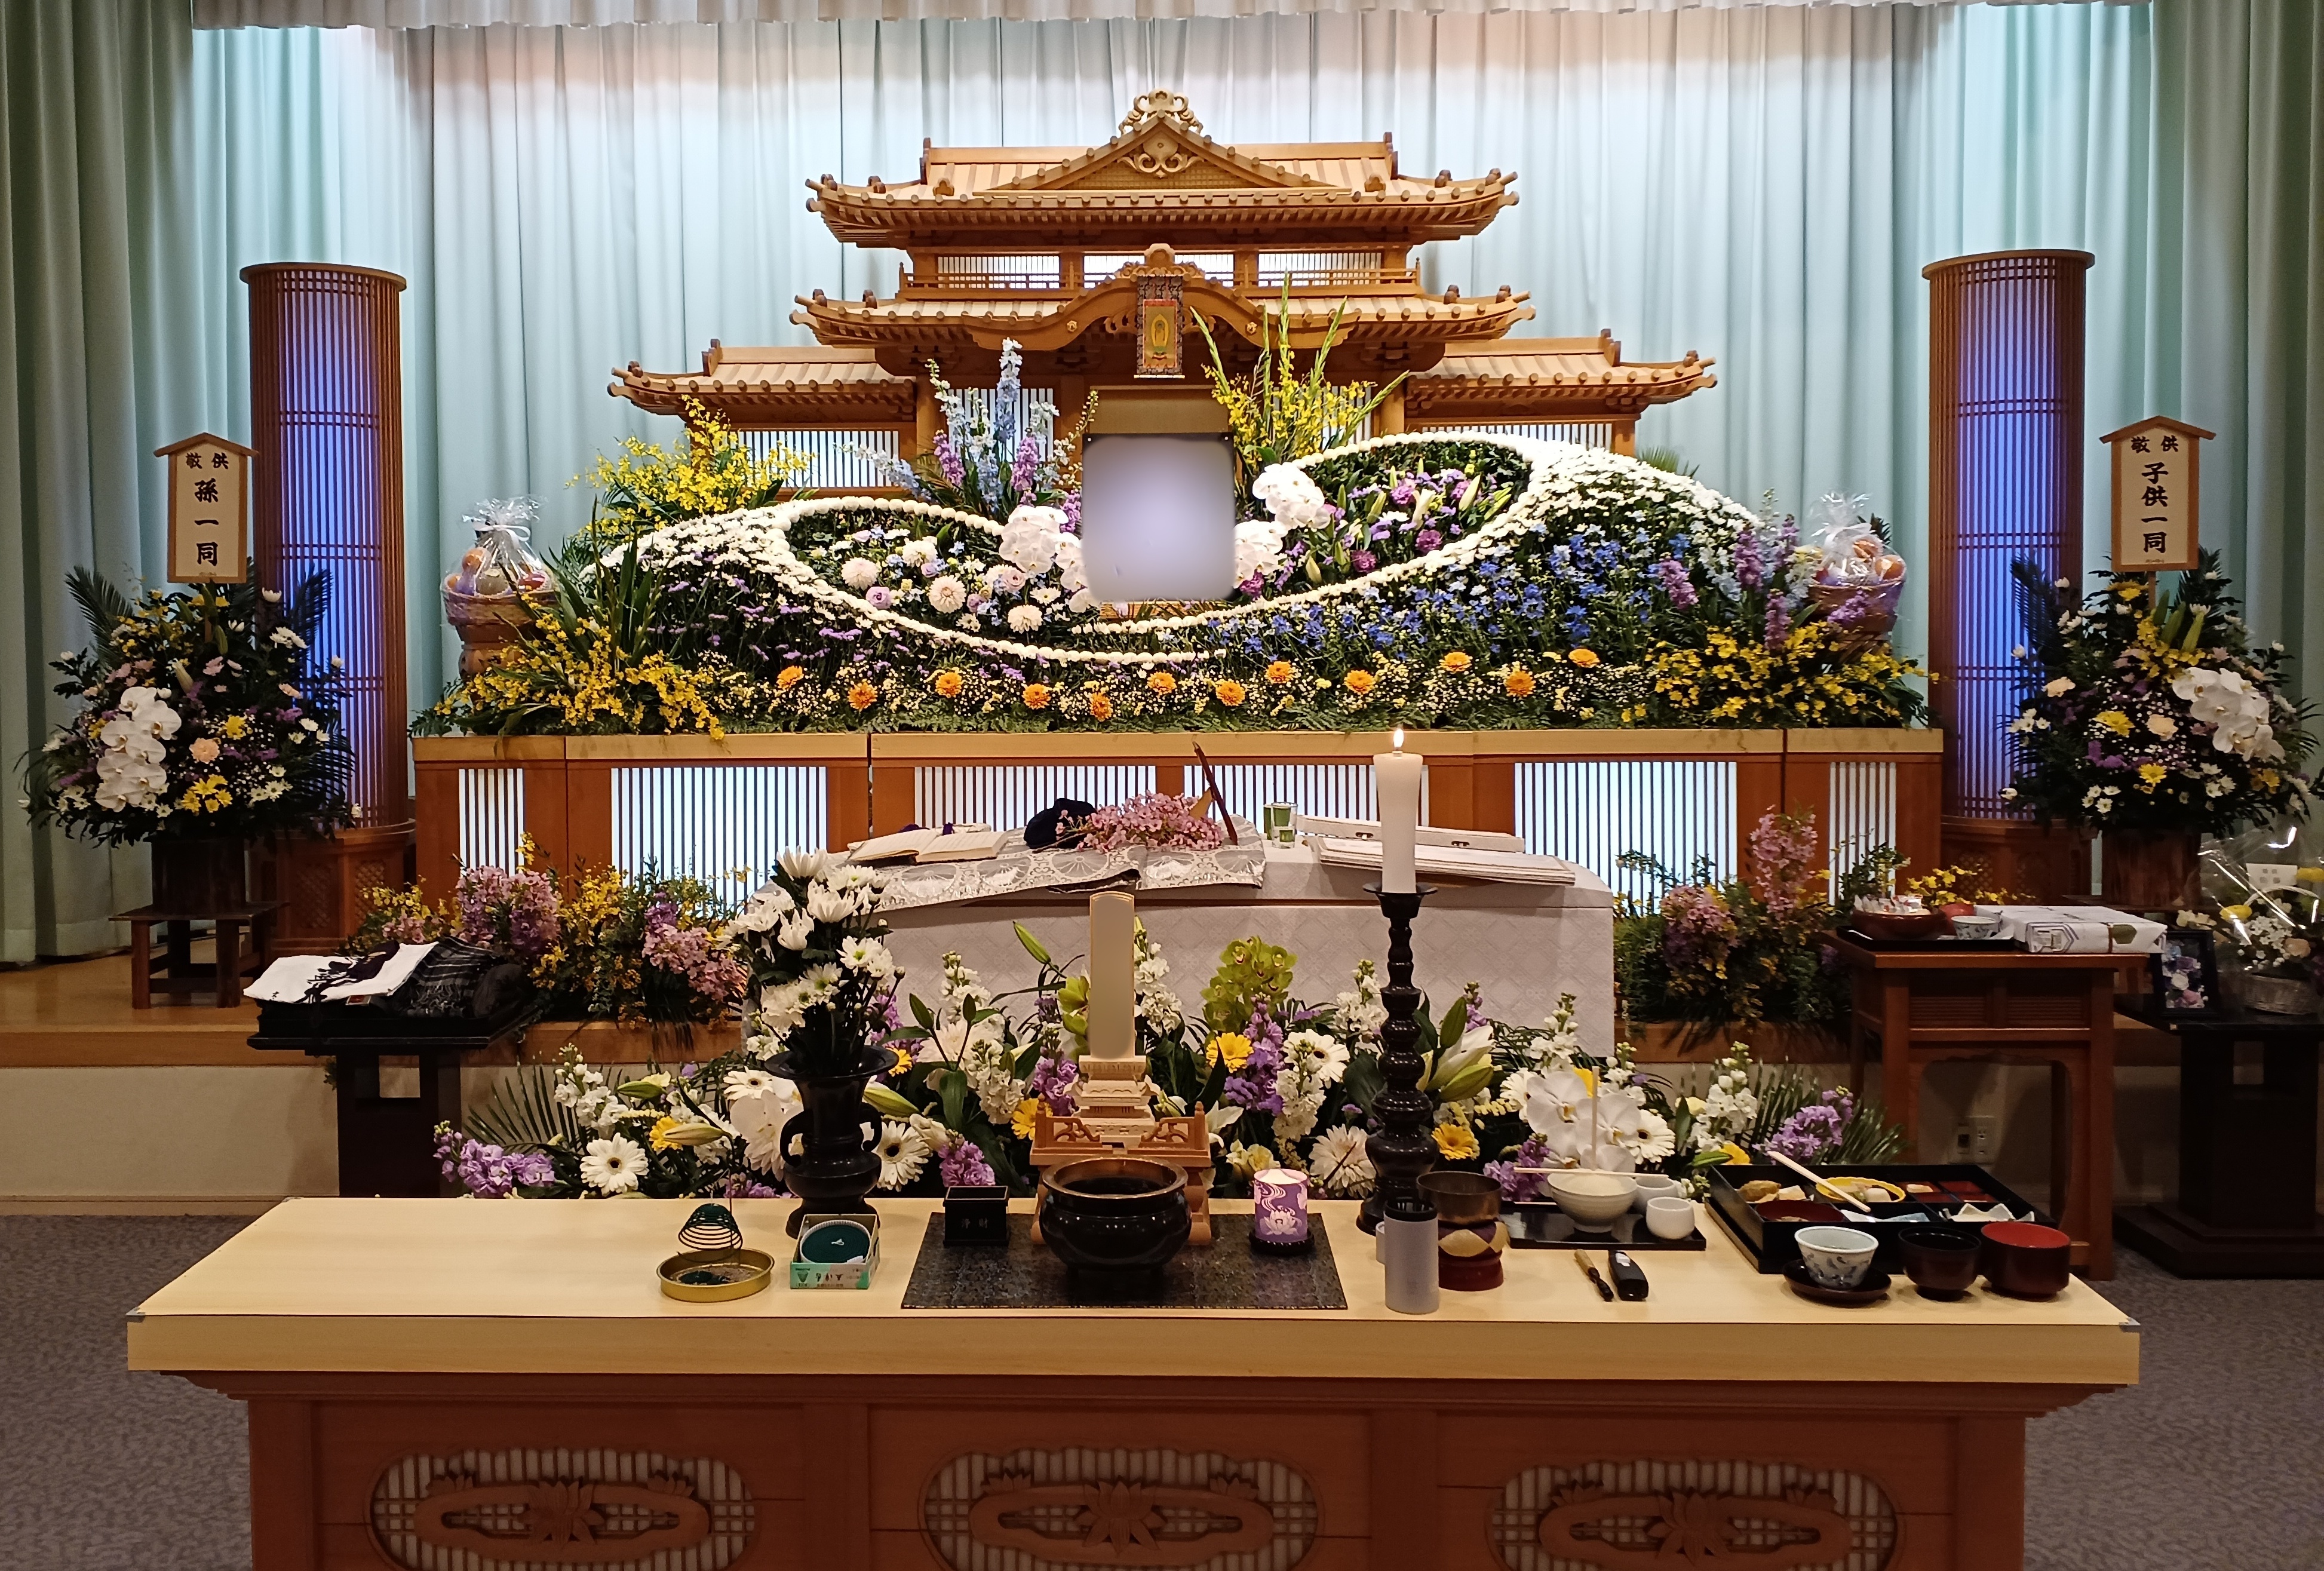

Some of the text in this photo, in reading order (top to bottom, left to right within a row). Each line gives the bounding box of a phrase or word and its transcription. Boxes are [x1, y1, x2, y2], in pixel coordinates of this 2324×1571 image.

[194, 477, 219, 566] 孫一同
[2141, 462, 2169, 554] 子供一同
